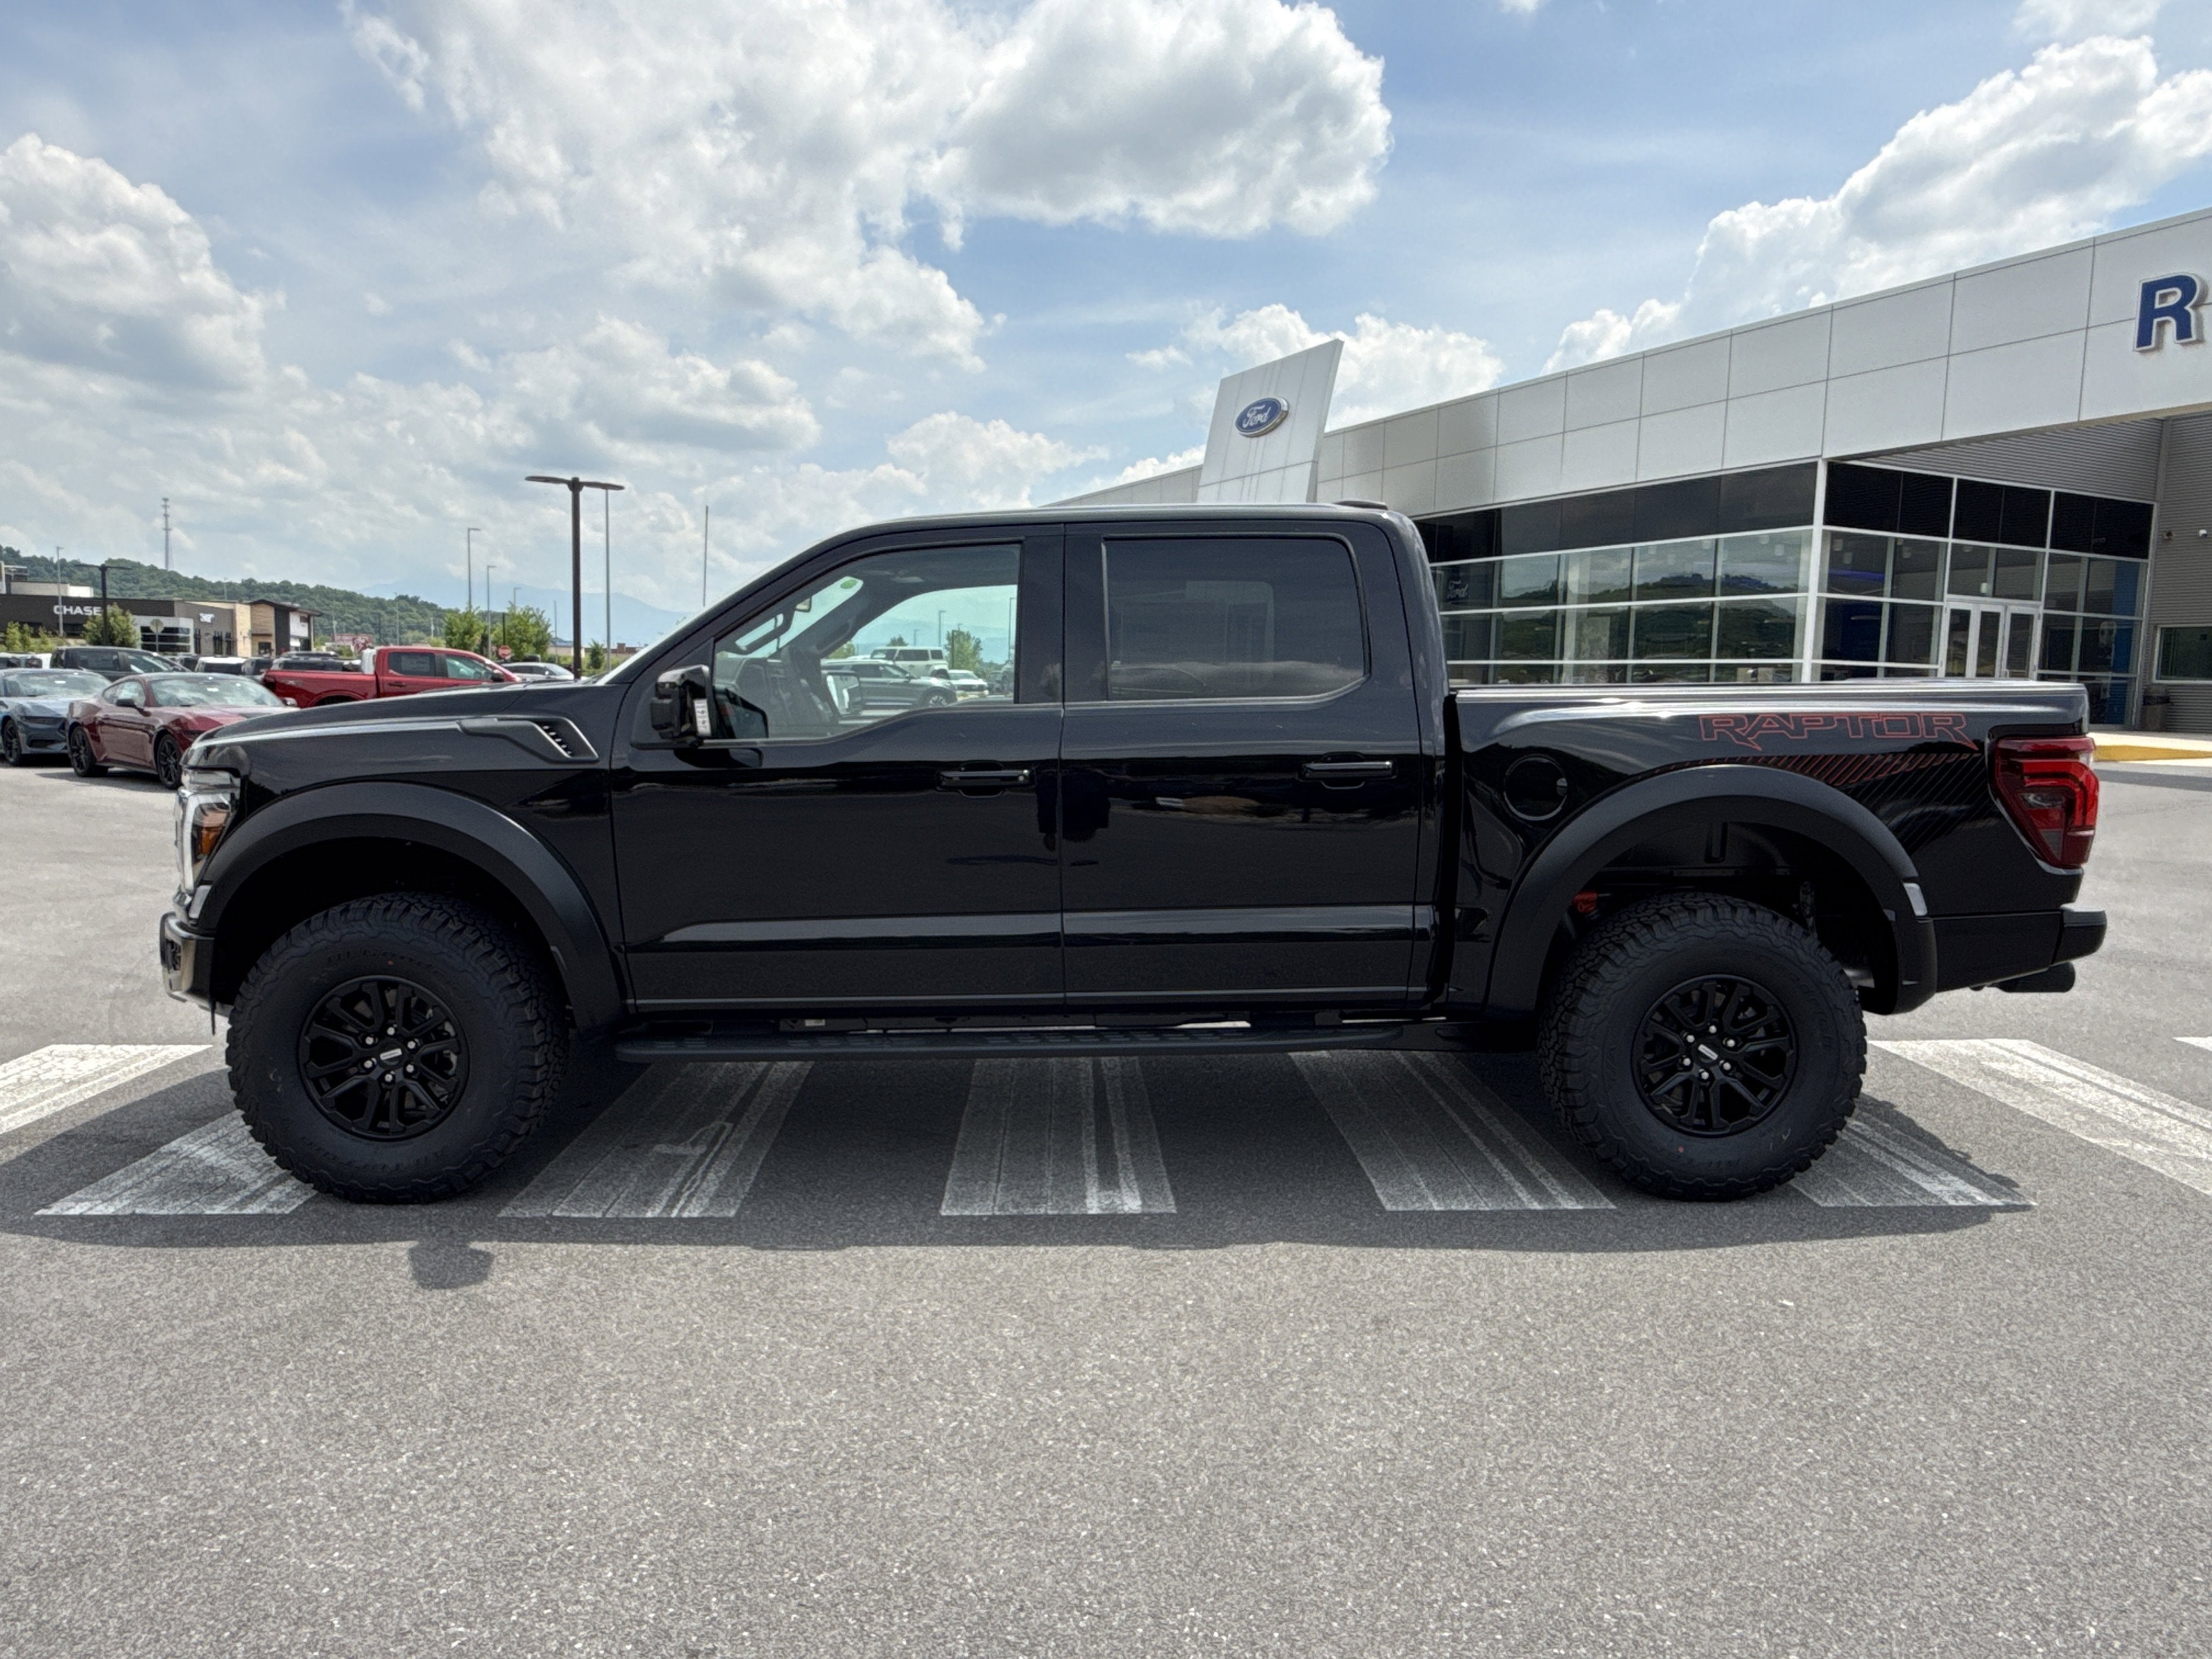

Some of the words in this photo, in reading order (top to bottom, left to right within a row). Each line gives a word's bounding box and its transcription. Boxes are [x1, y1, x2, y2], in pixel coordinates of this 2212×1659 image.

[1242, 404, 1272, 428] Ford
[1447, 580, 1469, 599] Ford
[53, 605, 102, 616] CHASE
[1699, 712, 1979, 751] RAPTOR
